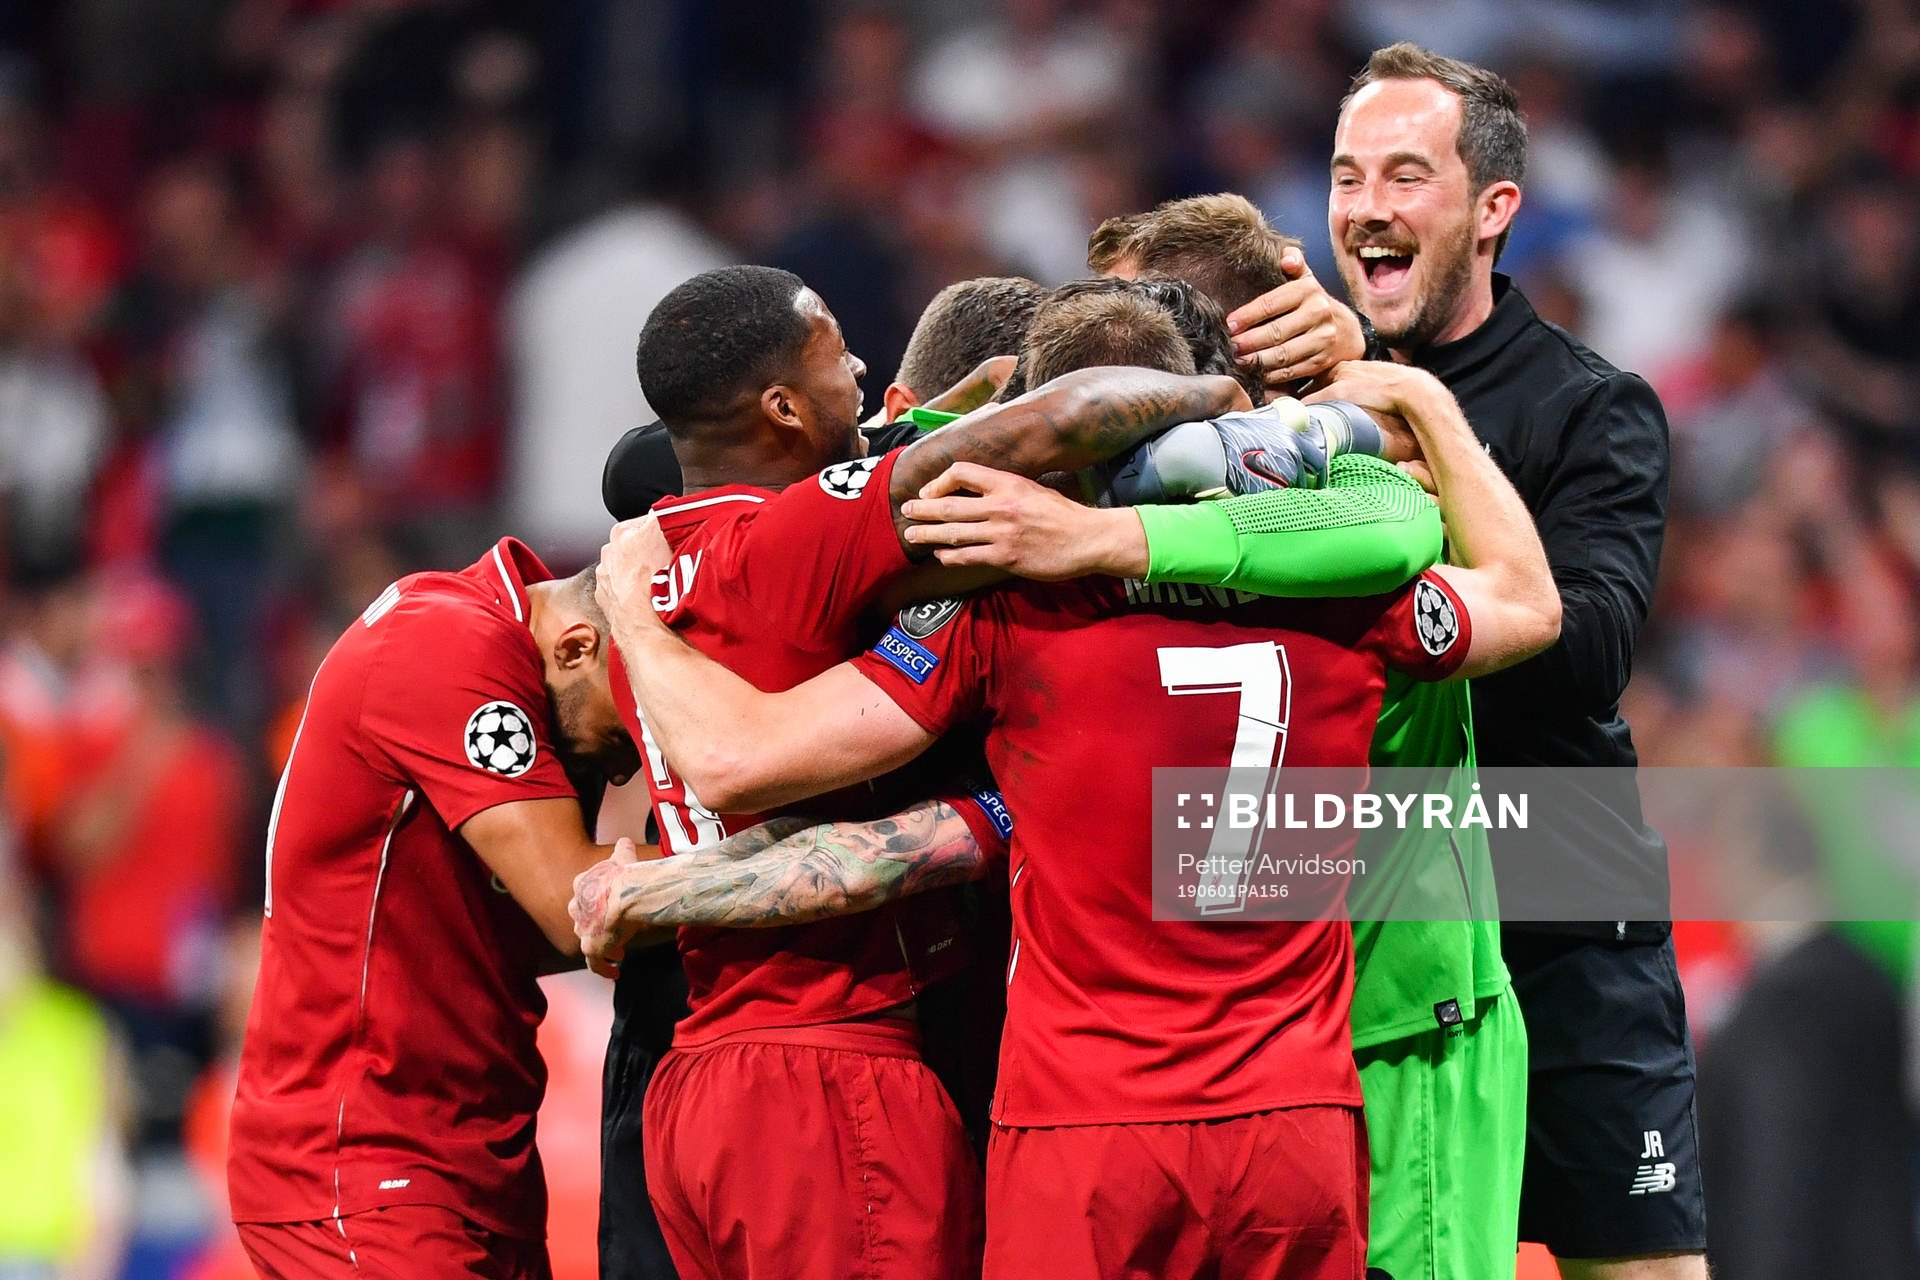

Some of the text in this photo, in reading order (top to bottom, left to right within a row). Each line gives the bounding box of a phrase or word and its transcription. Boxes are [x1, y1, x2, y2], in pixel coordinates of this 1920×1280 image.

[917, 603, 937, 620] 5
[880, 633, 934, 676] RESPECT
[1157, 640, 1292, 916] 7
[1641, 1130, 1665, 1158] JR
